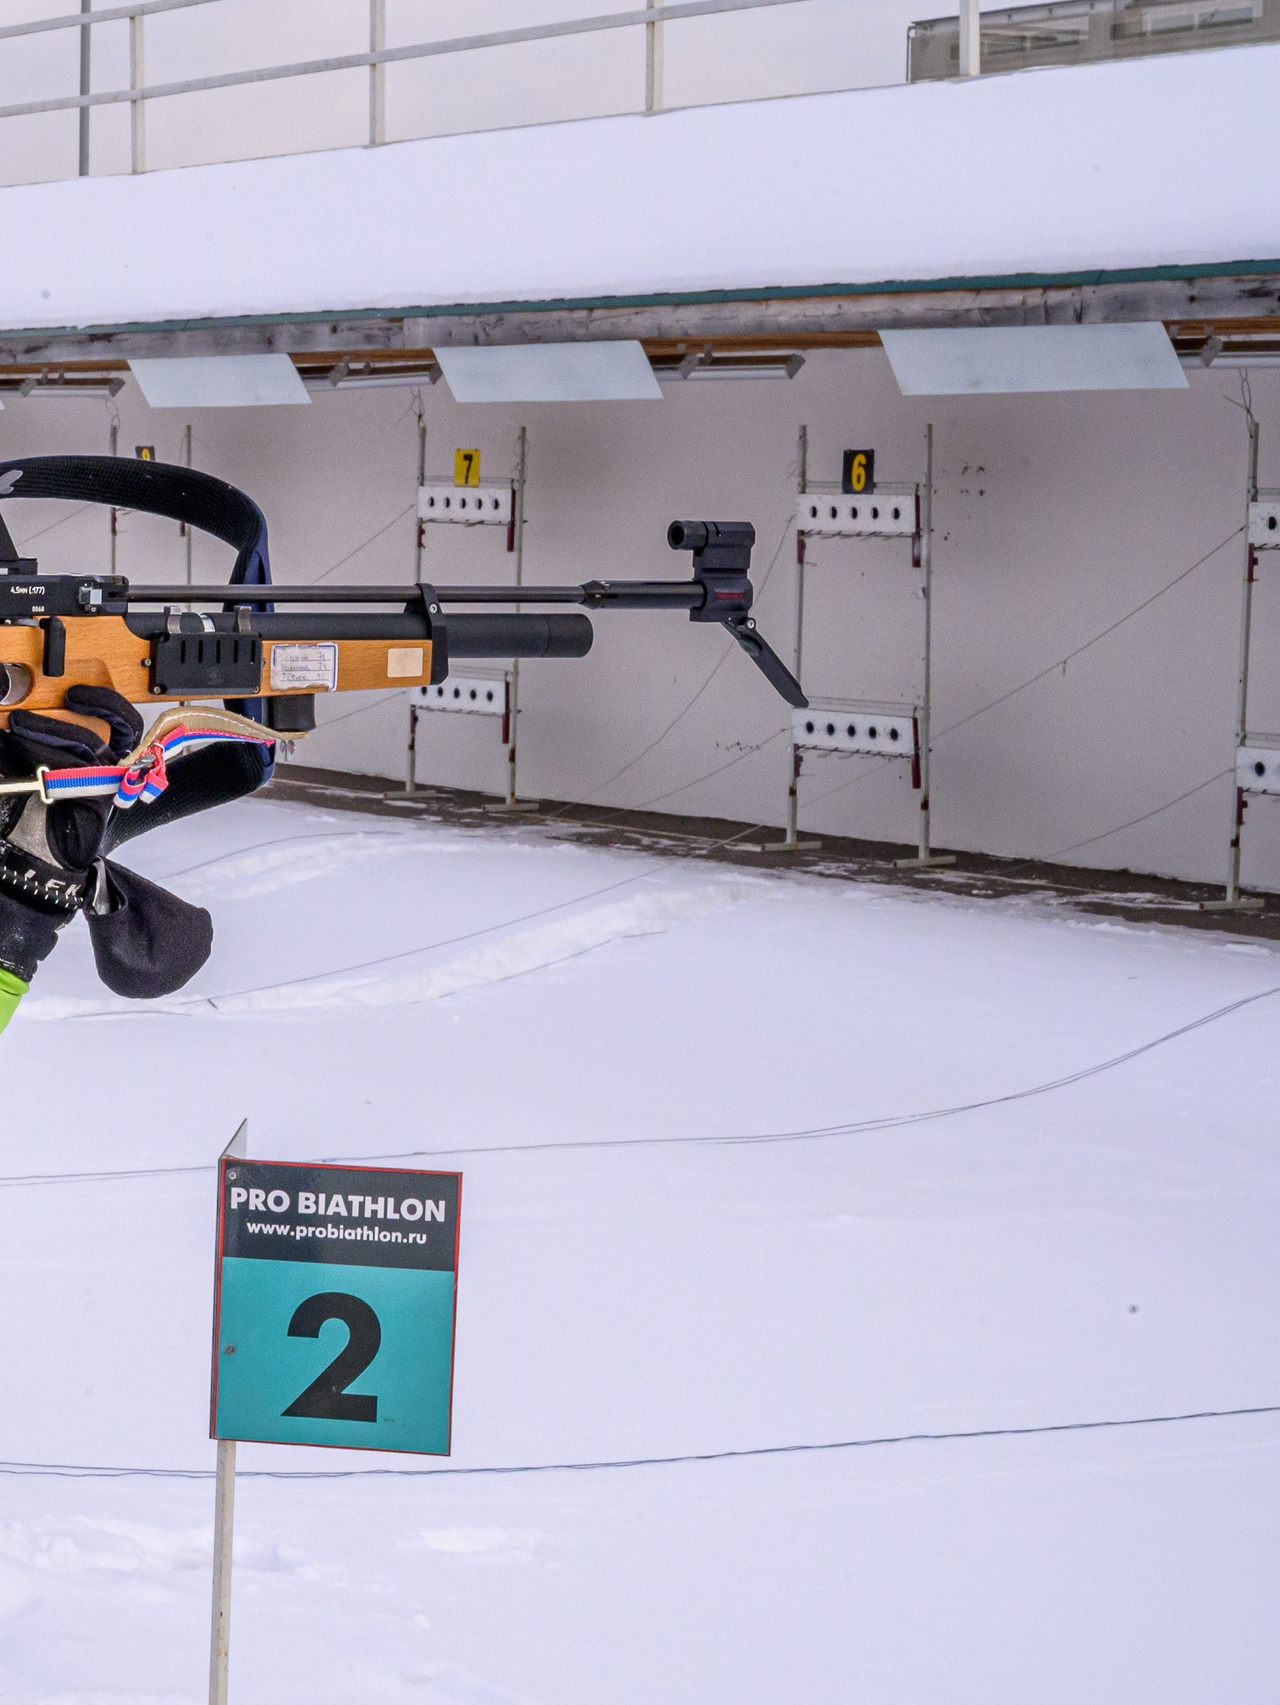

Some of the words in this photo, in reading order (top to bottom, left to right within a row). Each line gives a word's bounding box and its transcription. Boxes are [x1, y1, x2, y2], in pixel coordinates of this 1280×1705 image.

[463, 453, 473, 485] 7
[851, 453, 867, 492] 6
[230, 1187, 290, 1212] PRO
[297, 1191, 446, 1222] BIATHLON
[246, 1220, 428, 1244] www.probiathlon.ru
[280, 1291, 382, 1423] 2
